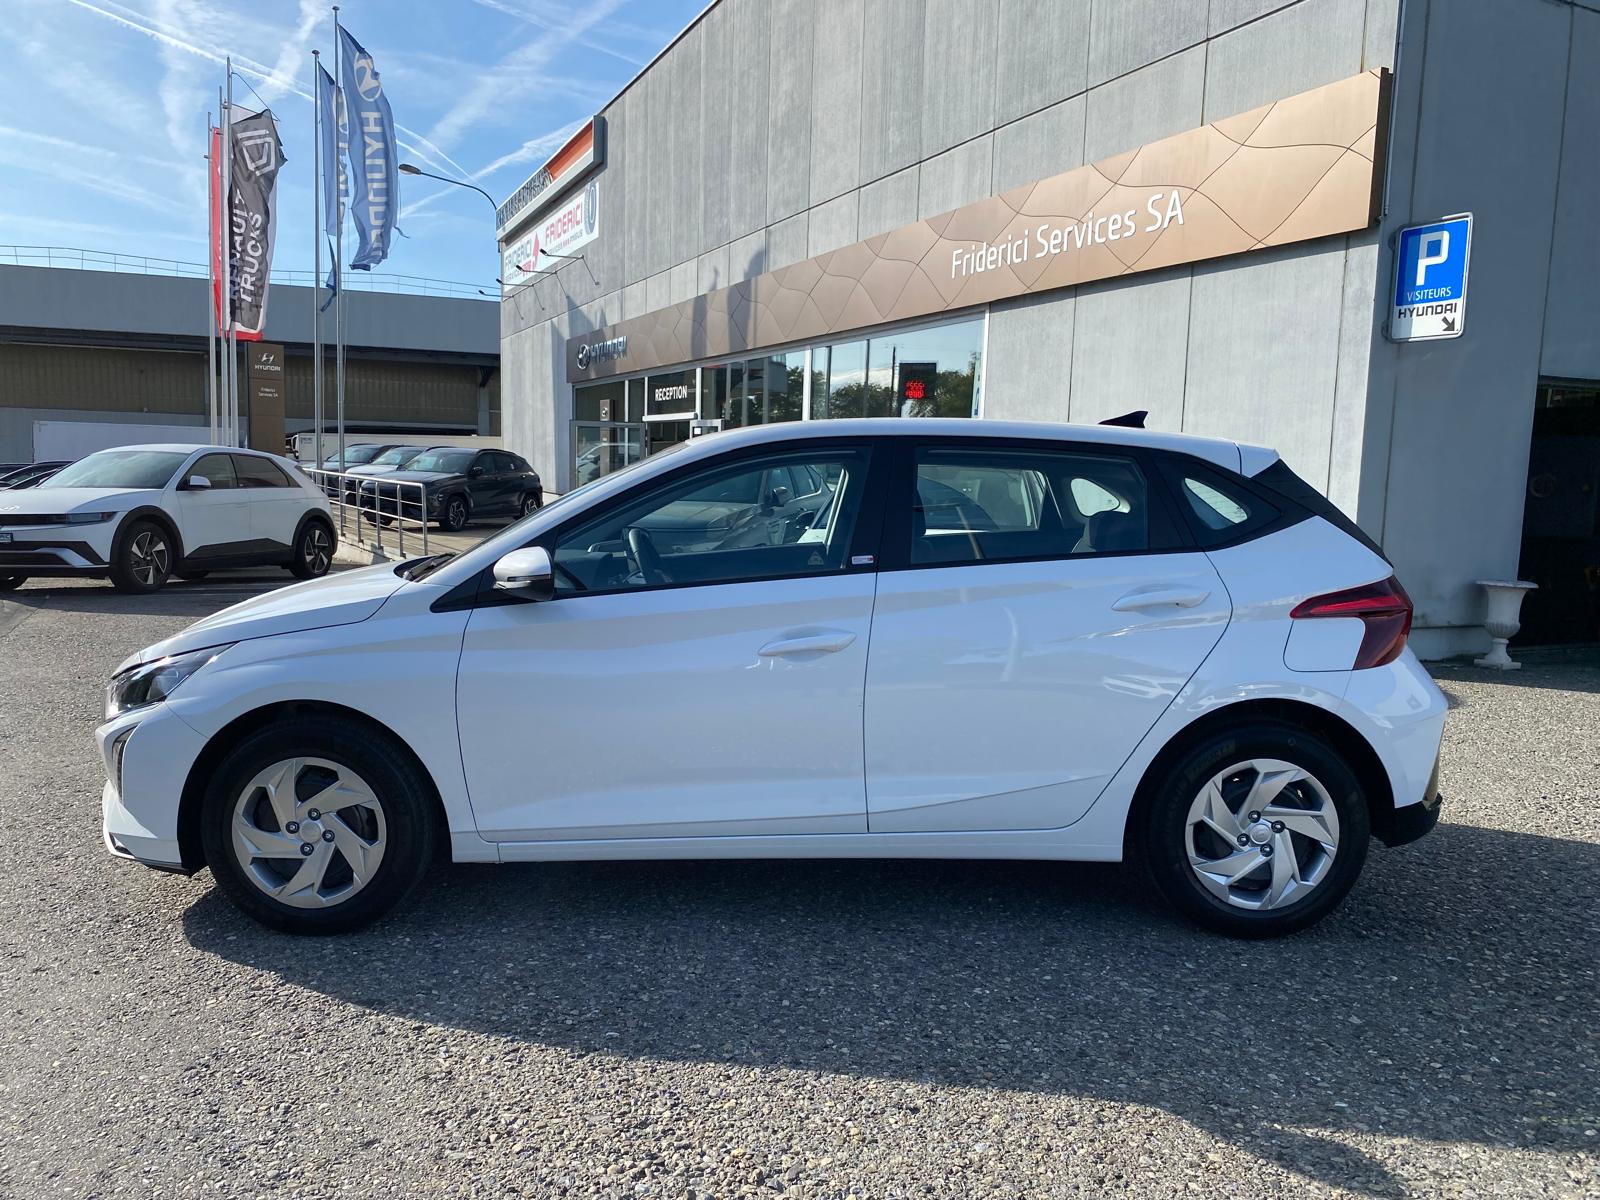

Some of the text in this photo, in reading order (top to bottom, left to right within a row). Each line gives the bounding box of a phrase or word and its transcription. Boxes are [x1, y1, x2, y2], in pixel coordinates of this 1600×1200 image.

[952, 190, 1184, 279] Friderici Services SA
[1416, 231, 1449, 286] P
[1407, 287, 1451, 301] VISITEURS
[1398, 303, 1457, 318] HYUNDAI
[655, 385, 688, 401] RECEPTION
